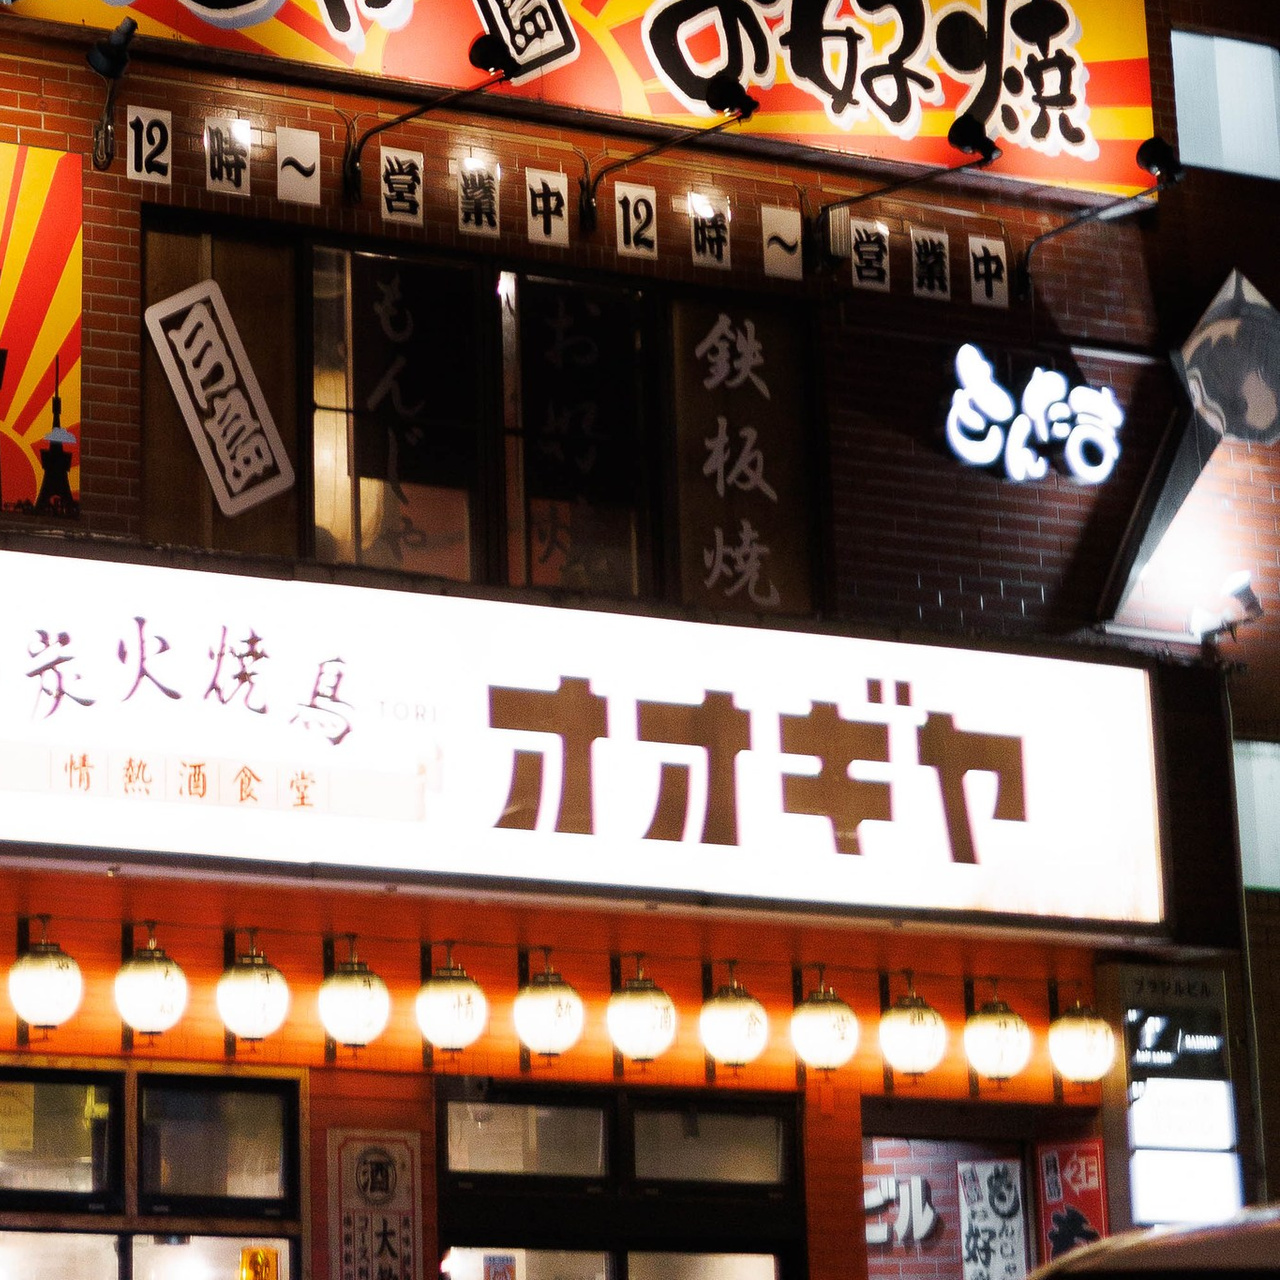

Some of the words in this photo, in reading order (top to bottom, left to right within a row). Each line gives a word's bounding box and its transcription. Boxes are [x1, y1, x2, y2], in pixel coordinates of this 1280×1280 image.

[695, 313, 780, 609] 鉄板焼
[25, 615, 356, 745] 炭火焼鳥
[378, 700, 437, 724] TORI
[63, 752, 318, 809] 情熱酒食堂
[488, 675, 1026, 864] オオギヤ
